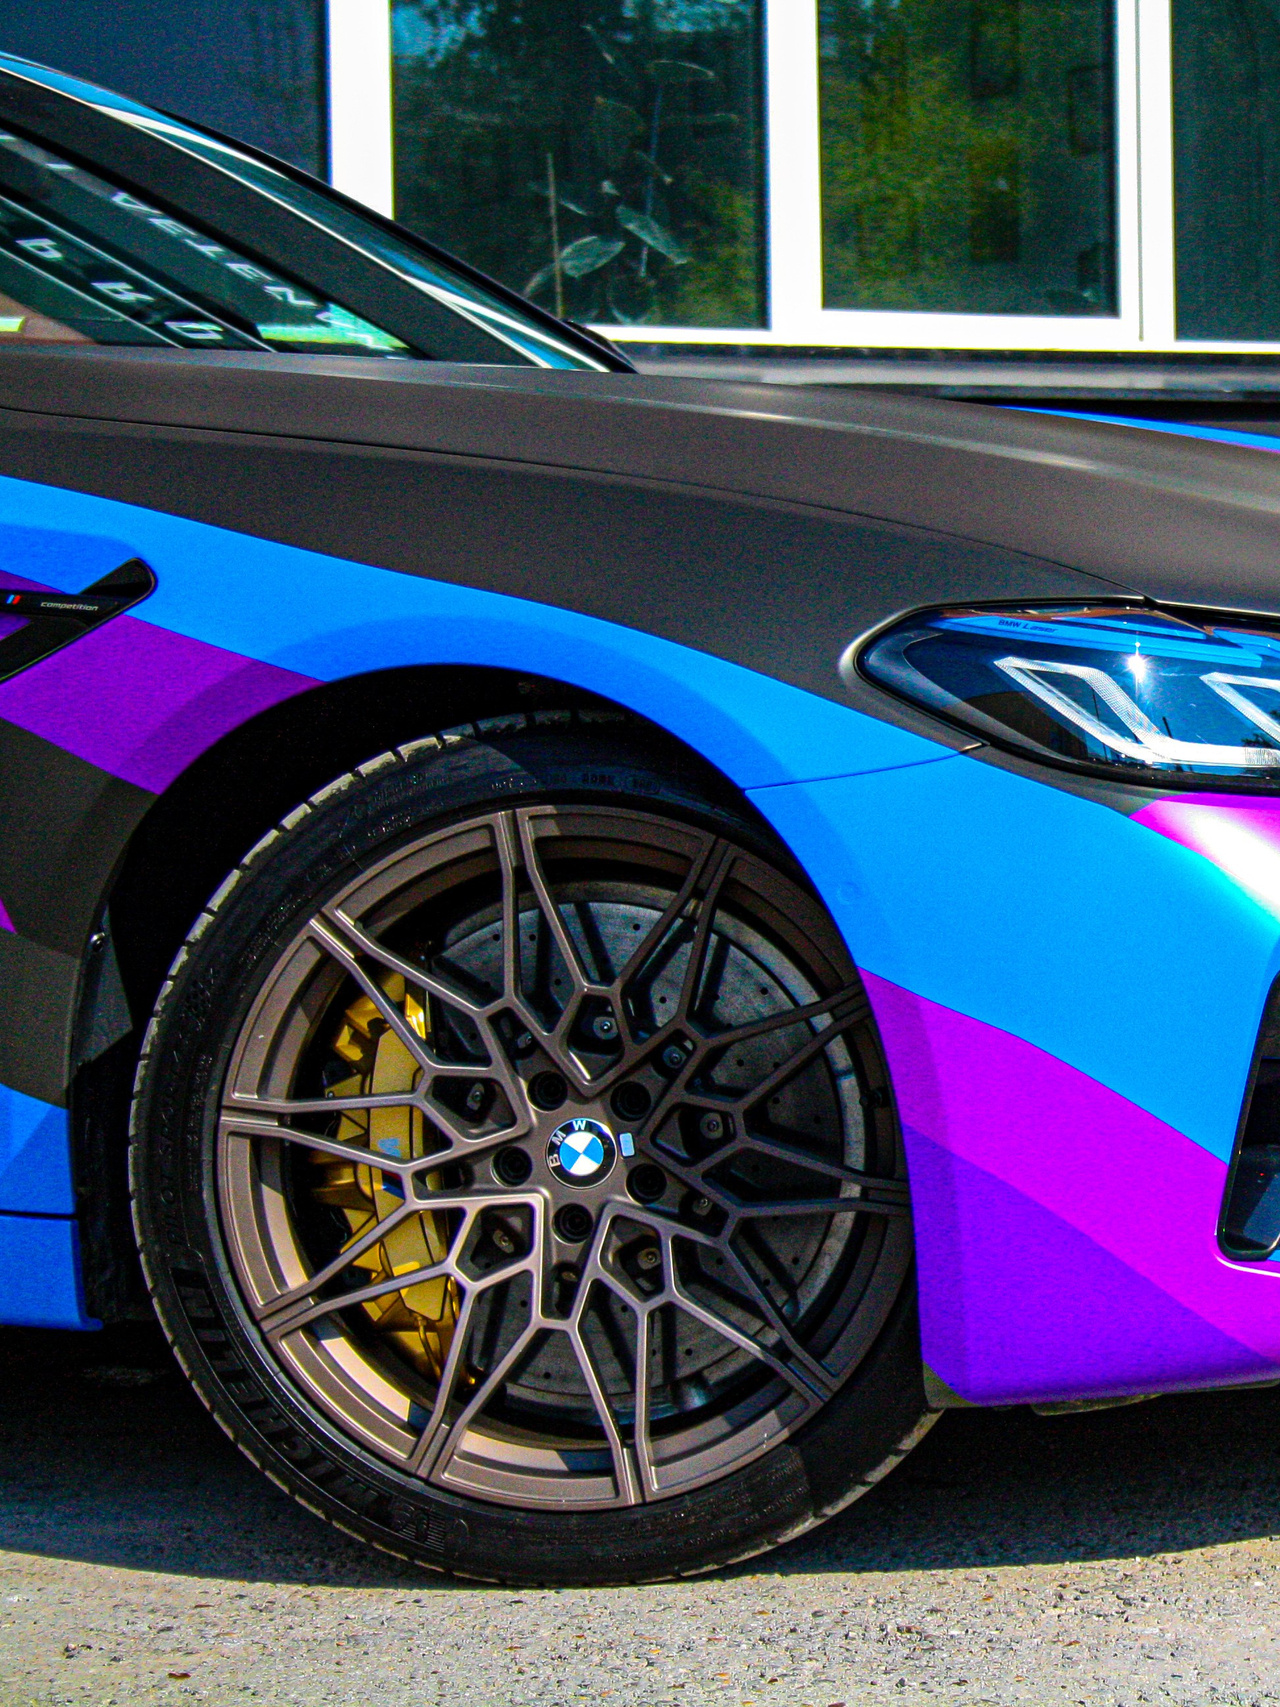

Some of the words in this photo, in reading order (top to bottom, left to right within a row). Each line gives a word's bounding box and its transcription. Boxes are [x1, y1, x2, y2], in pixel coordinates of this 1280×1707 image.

[998, 619, 1021, 629] BMW
[1022, 622, 1058, 634] Laser
[548, 1119, 587, 1169] BMW
